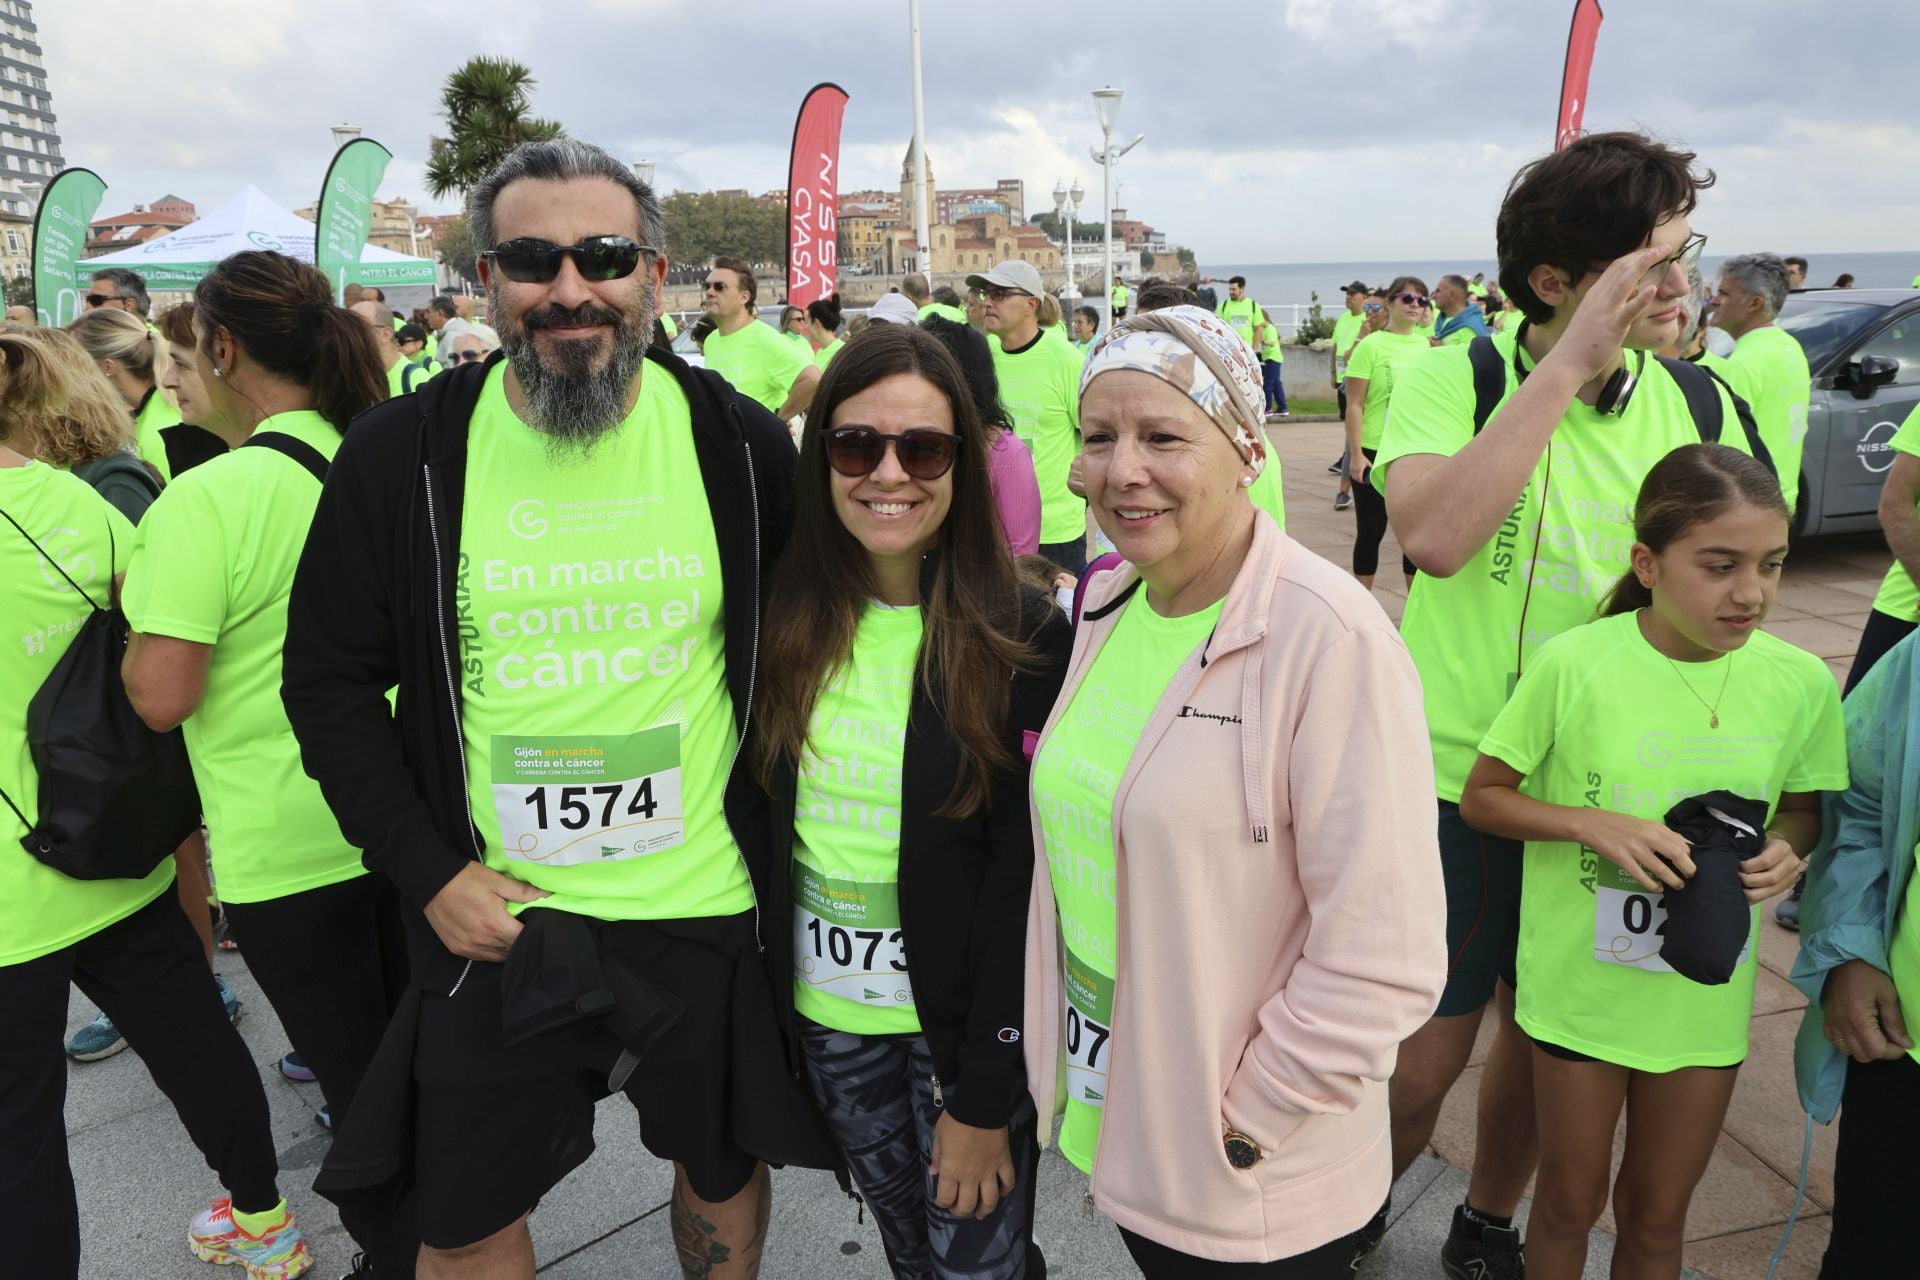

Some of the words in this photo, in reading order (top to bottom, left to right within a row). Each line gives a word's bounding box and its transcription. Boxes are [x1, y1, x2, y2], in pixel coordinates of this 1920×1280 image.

[792, 187, 812, 290] CYASA
[819, 153, 836, 300] NISSA
[1856, 442, 1893, 453] NISS
[483, 559, 536, 592] En
[550, 548, 705, 588] marcha
[457, 551, 486, 698] ASTURIAS
[488, 597, 651, 638] contra
[660, 589, 701, 629] el
[495, 637, 698, 690] cáncer
[514, 746, 542, 759] Gijón
[544, 749, 559, 757] en
[561, 746, 604, 757] marcha
[514, 759, 551, 768] contra
[553, 758, 564, 768] el
[566, 758, 605, 768] cáncer
[525, 777, 658, 830] 1574
[1611, 784, 1657, 811] En
[1579, 771, 1602, 895] ASTAS
[803, 887, 825, 903] contra
[832, 900, 867, 912] cáncer
[807, 918, 909, 972] 1073
